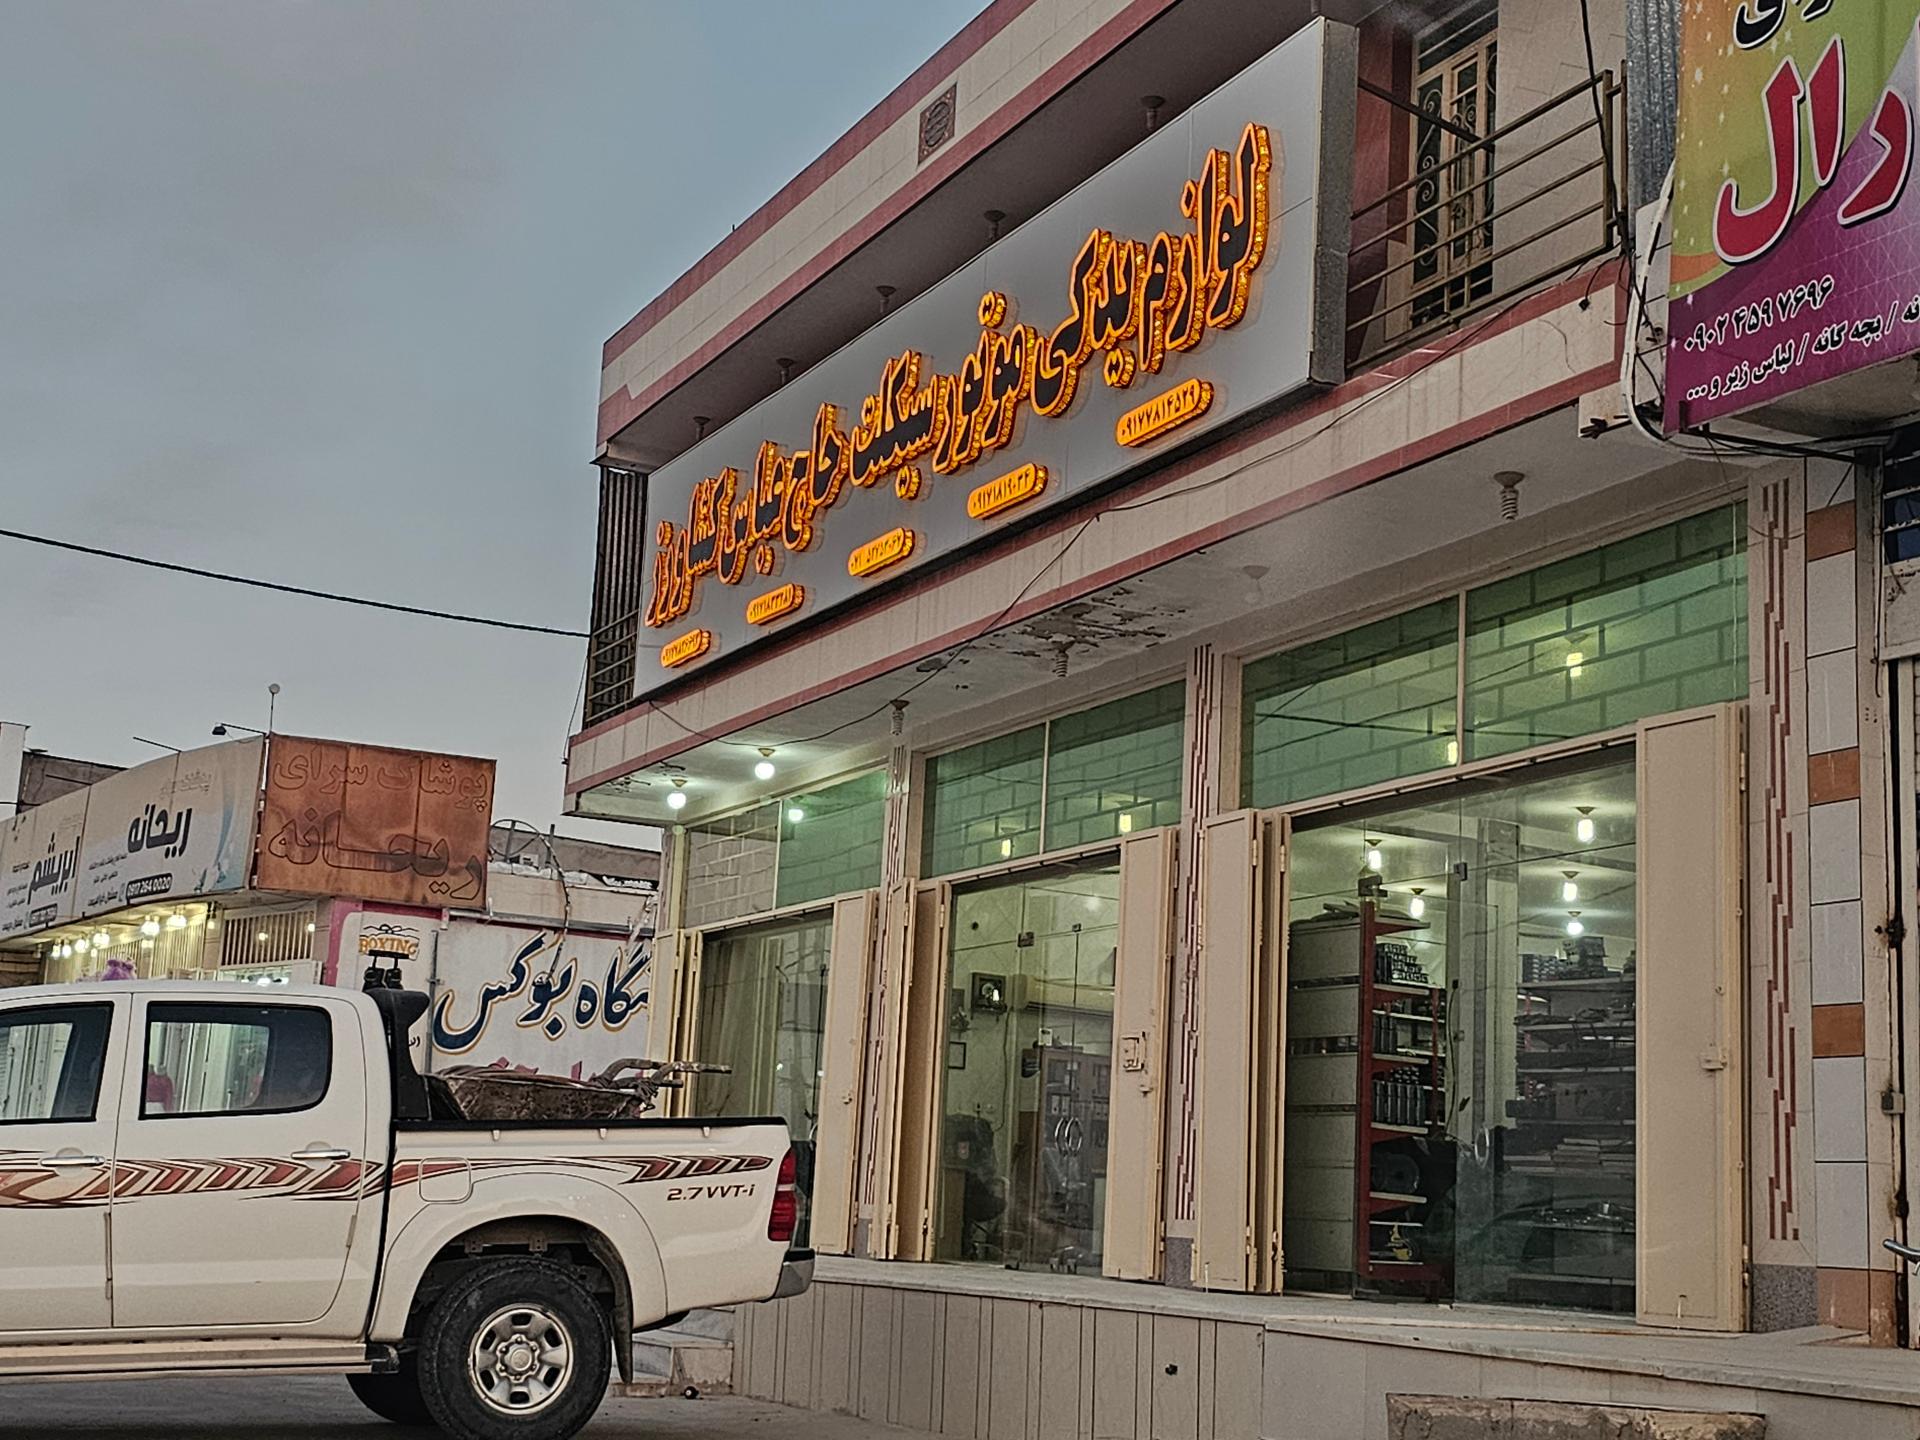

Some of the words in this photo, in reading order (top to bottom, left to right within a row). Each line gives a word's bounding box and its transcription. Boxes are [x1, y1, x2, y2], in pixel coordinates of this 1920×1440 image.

[1713, 33, 1920, 265] رال
[1138, 121, 1272, 375] لوازم
[1684, 314, 1728, 351] ۰۹۰۲
[1732, 298, 1772, 338] ۴۵۹
[1777, 275, 1834, 321] ۷۶۹۶
[1850, 315, 1882, 346] بچه
[1722, 361, 1750, 395] زیر
[1752, 340, 1795, 383] لباس
[645, 467, 737, 628] کشاورز
[718, 440, 789, 585] عباس
[273, 747, 368, 795] سرای
[128, 803, 193, 859] ریحانه
[268, 808, 483, 900] ریحانه
[27, 832, 81, 905] ابریشم
[358, 937, 417, 956] BOXING
[432, 929, 577, 1055] بوکس
